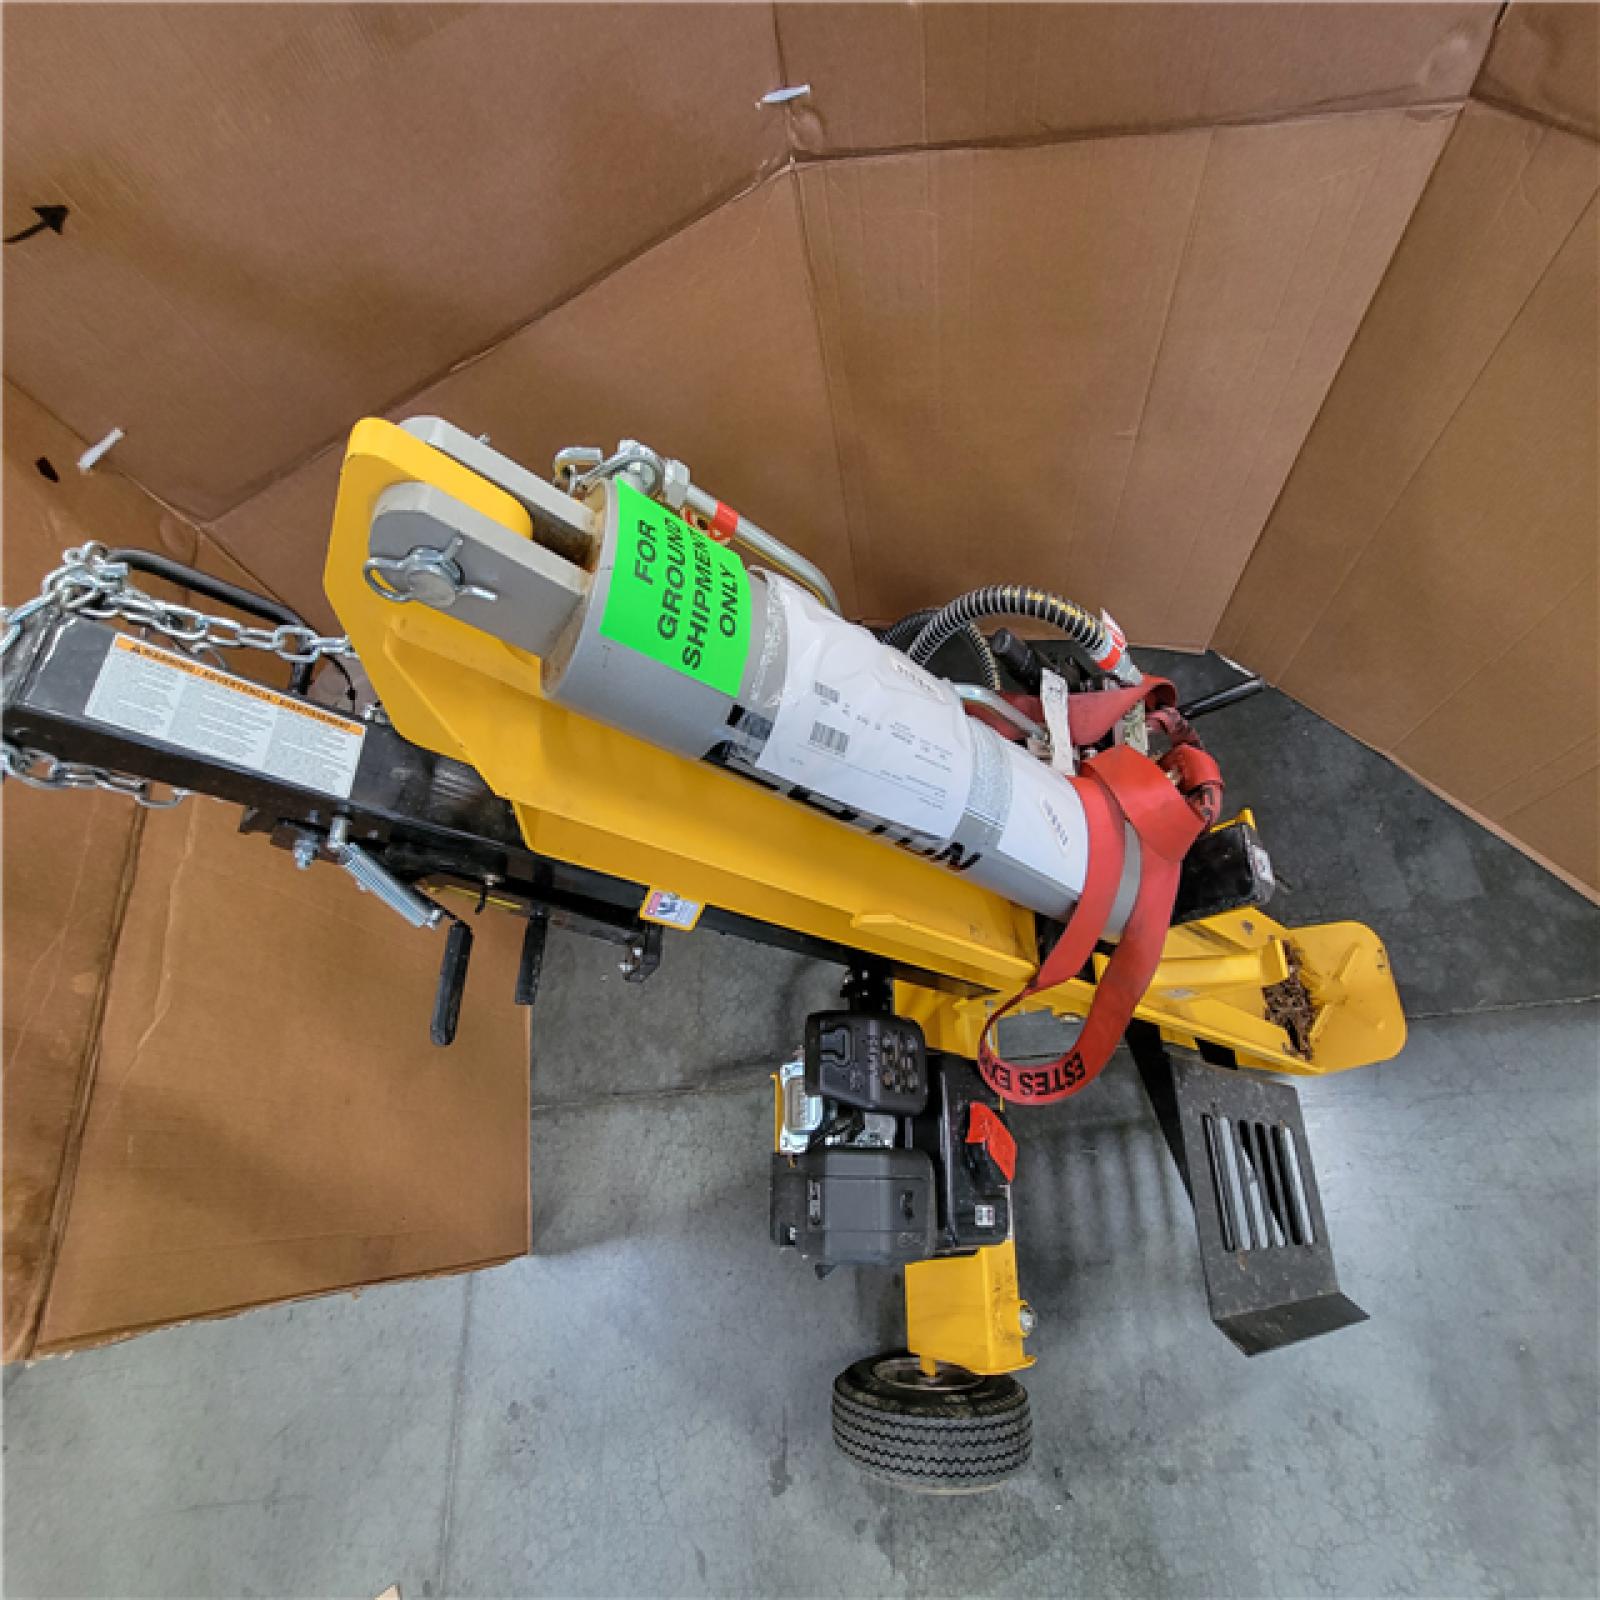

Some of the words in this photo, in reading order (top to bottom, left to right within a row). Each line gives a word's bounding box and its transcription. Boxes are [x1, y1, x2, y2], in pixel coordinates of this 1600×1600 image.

[635, 519, 658, 586] FOR
[657, 516, 686, 641] GROUND
[682, 527, 713, 671] SHIPMENT
[719, 561, 739, 638] ONLY
[1019, 1052, 1086, 1096] ESTES
